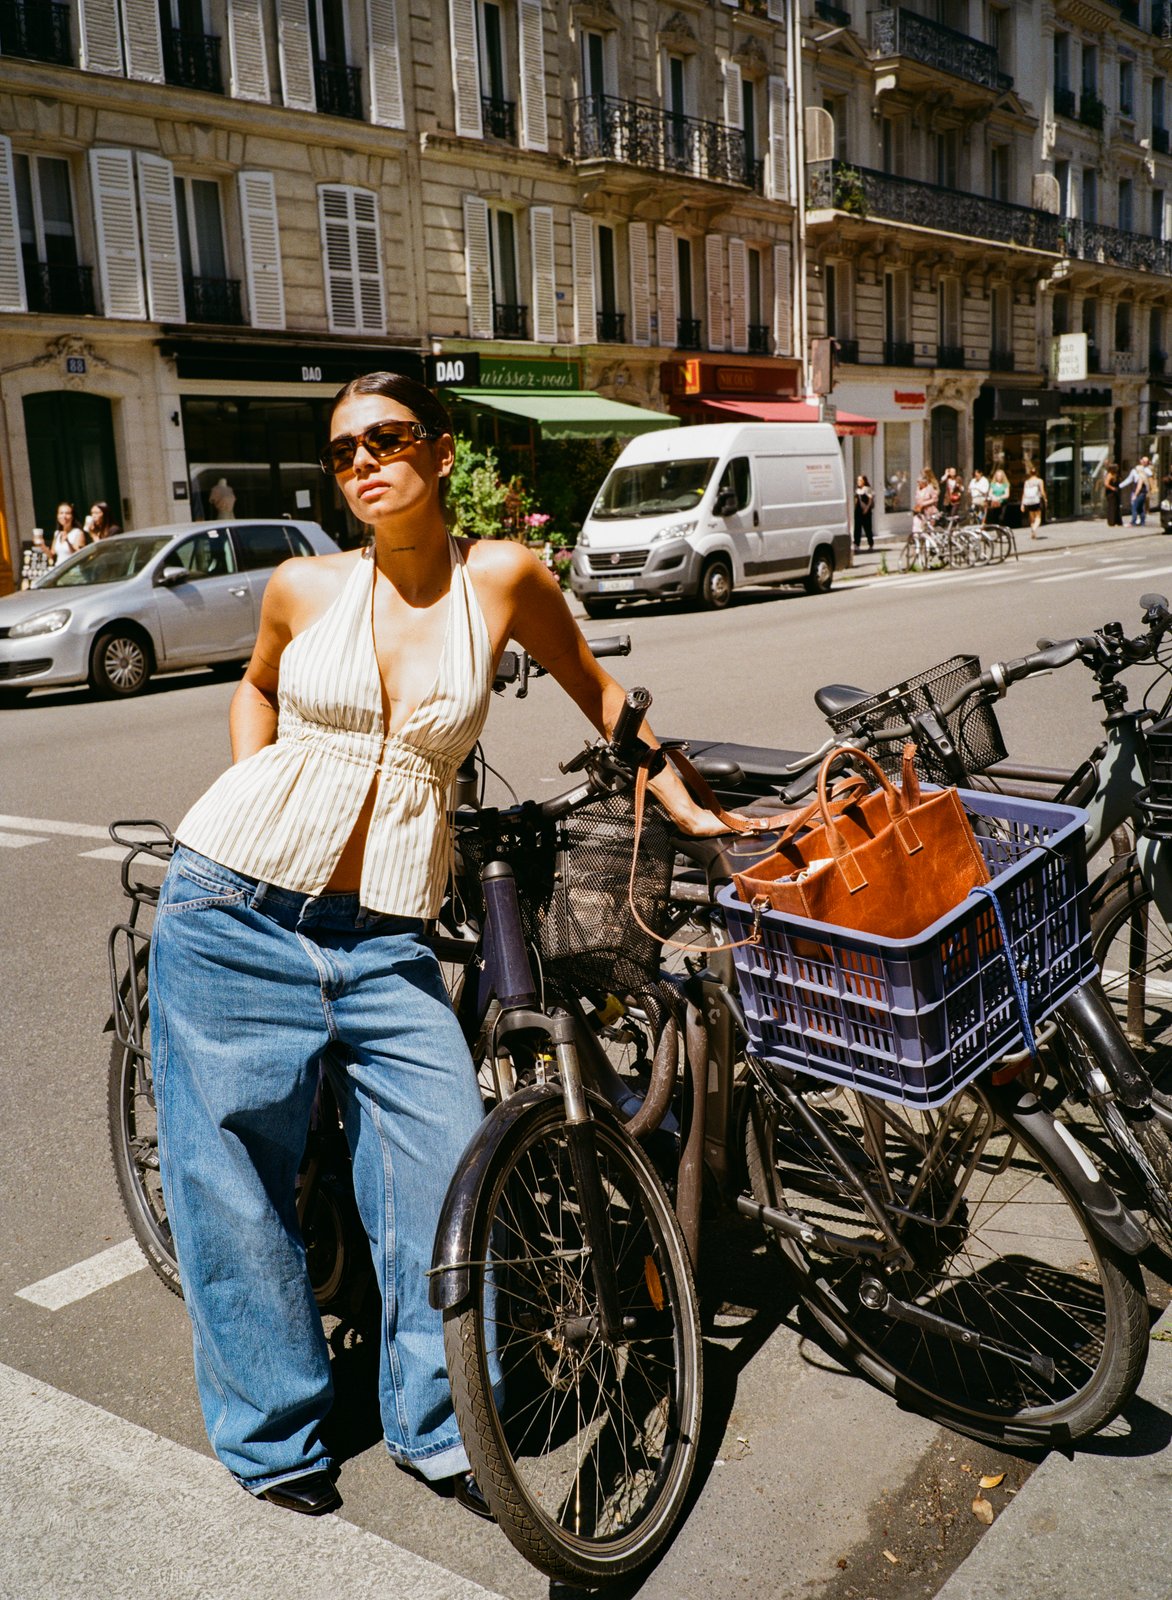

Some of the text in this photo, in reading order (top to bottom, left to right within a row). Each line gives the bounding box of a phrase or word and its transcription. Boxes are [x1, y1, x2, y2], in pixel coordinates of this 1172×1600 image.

[301, 366, 322, 381] DAO
[436, 360, 465, 382] DAO
[480, 367, 573, 386] urissez-vous
